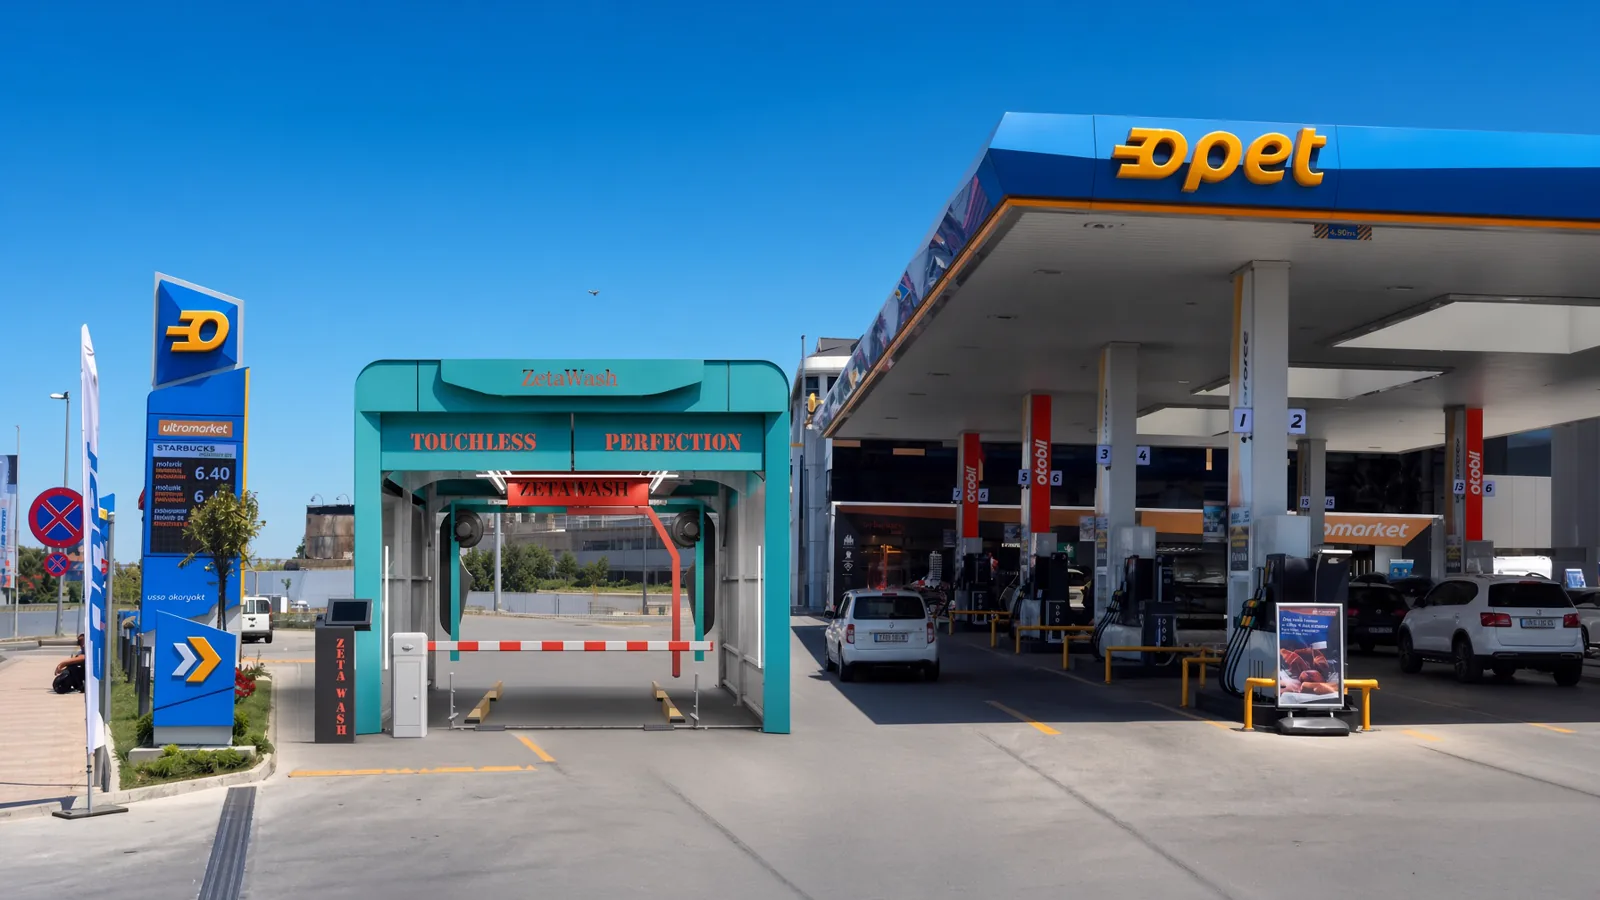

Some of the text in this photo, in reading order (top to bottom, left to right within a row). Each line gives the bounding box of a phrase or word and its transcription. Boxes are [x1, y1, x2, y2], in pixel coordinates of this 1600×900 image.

[521, 369, 619, 387] ZetaWash
[1291, 414, 1302, 428] 2
[411, 433, 742, 451] TOUCHLESS PERFECTION
[1101, 450, 1108, 459] 3
[1139, 450, 1146, 460] 4
[195, 466, 230, 481] 6.40
[1022, 473, 1028, 482] 5
[1053, 474, 1060, 482] 6
[1485, 484, 1492, 493] 6
[336, 638, 348, 735] ZETA WASH
